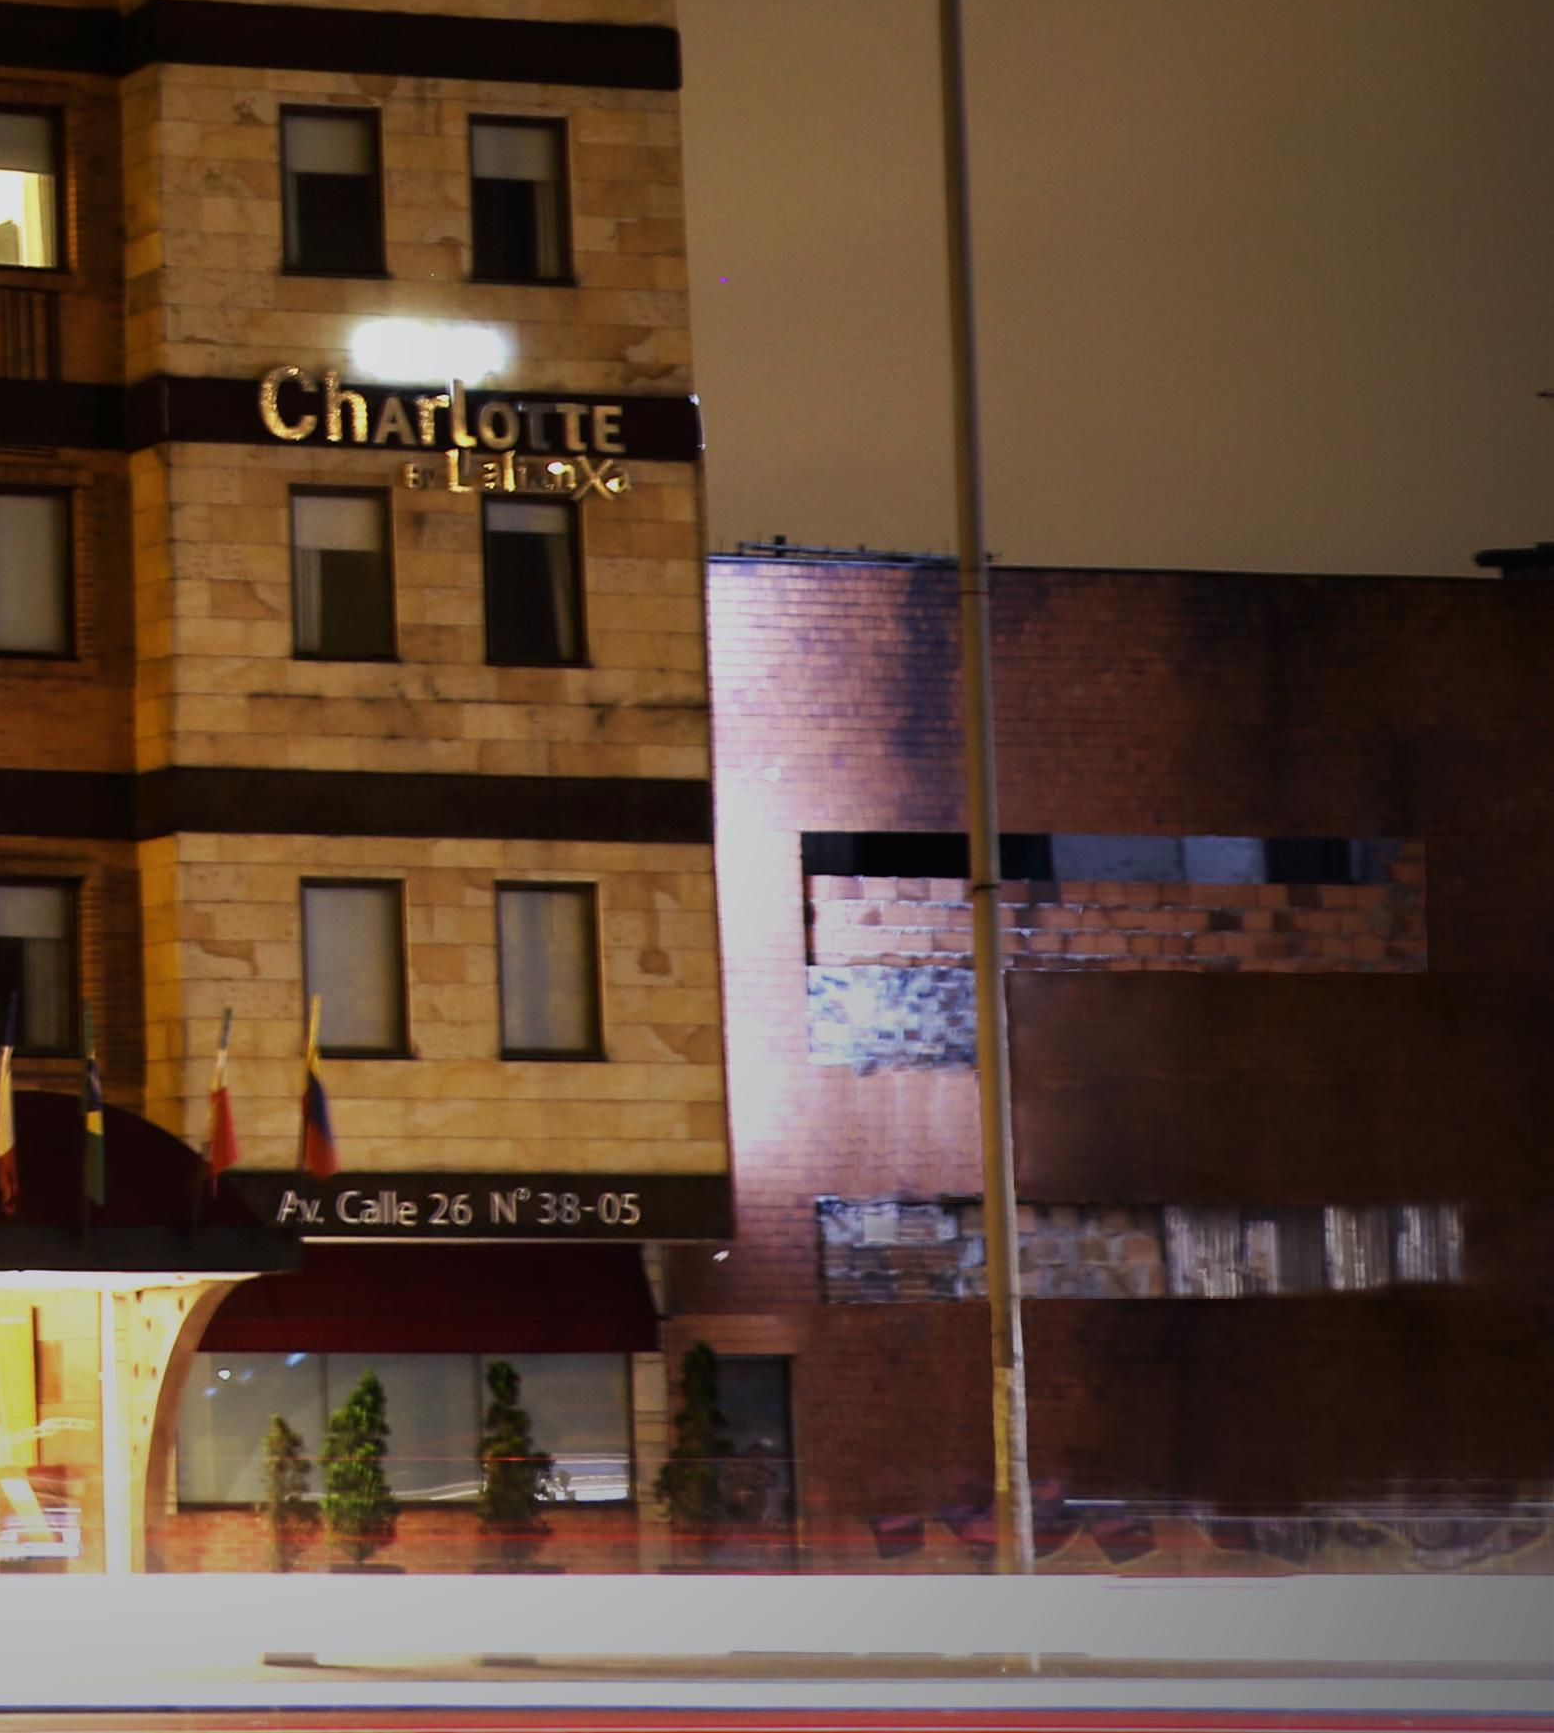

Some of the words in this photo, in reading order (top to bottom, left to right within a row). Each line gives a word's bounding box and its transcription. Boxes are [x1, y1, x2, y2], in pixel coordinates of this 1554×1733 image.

[275, 1189, 325, 1224] Av.
[335, 1190, 418, 1226] Calle
[427, 1192, 474, 1225] 26
[536, 1192, 642, 1225] 38-05
